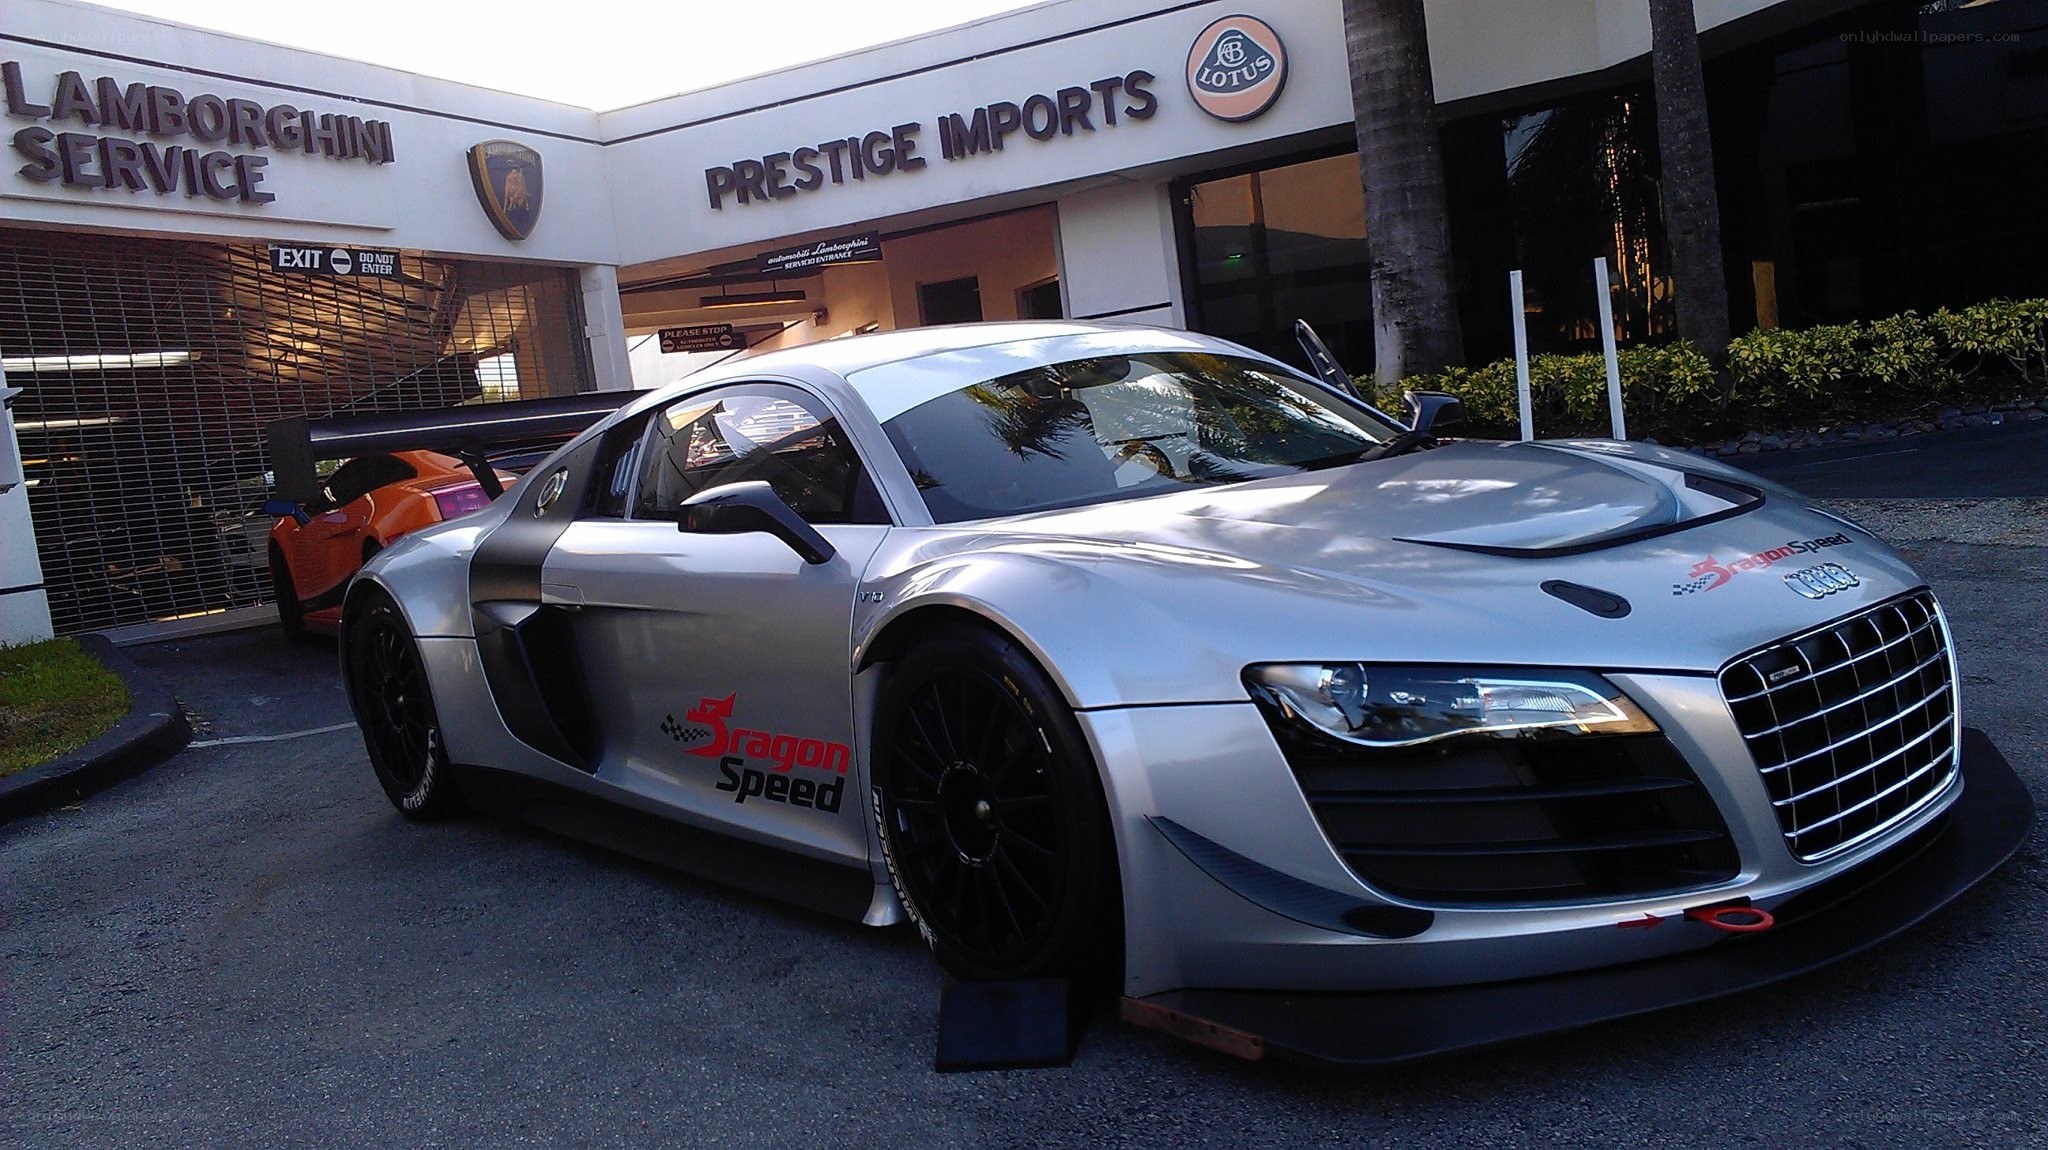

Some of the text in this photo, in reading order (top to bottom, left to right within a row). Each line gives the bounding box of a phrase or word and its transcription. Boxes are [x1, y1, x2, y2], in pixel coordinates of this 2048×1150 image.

[1199, 55, 1271, 87] LOTUS
[1, 60, 395, 164] LAMBORGHINI
[705, 69, 1157, 209] PRESTIGE IMPORTS
[13, 126, 275, 204] SERVICE
[279, 248, 322, 269] EXIT
[359, 252, 394, 265] DO NOT
[768, 238, 868, 264] automobili Lamborghini
[816, 251, 852, 263] ENTRANCE
[362, 263, 393, 275] ENTER
[665, 326, 727, 338] PLEASE STOP
[714, 756, 846, 814] Speed
